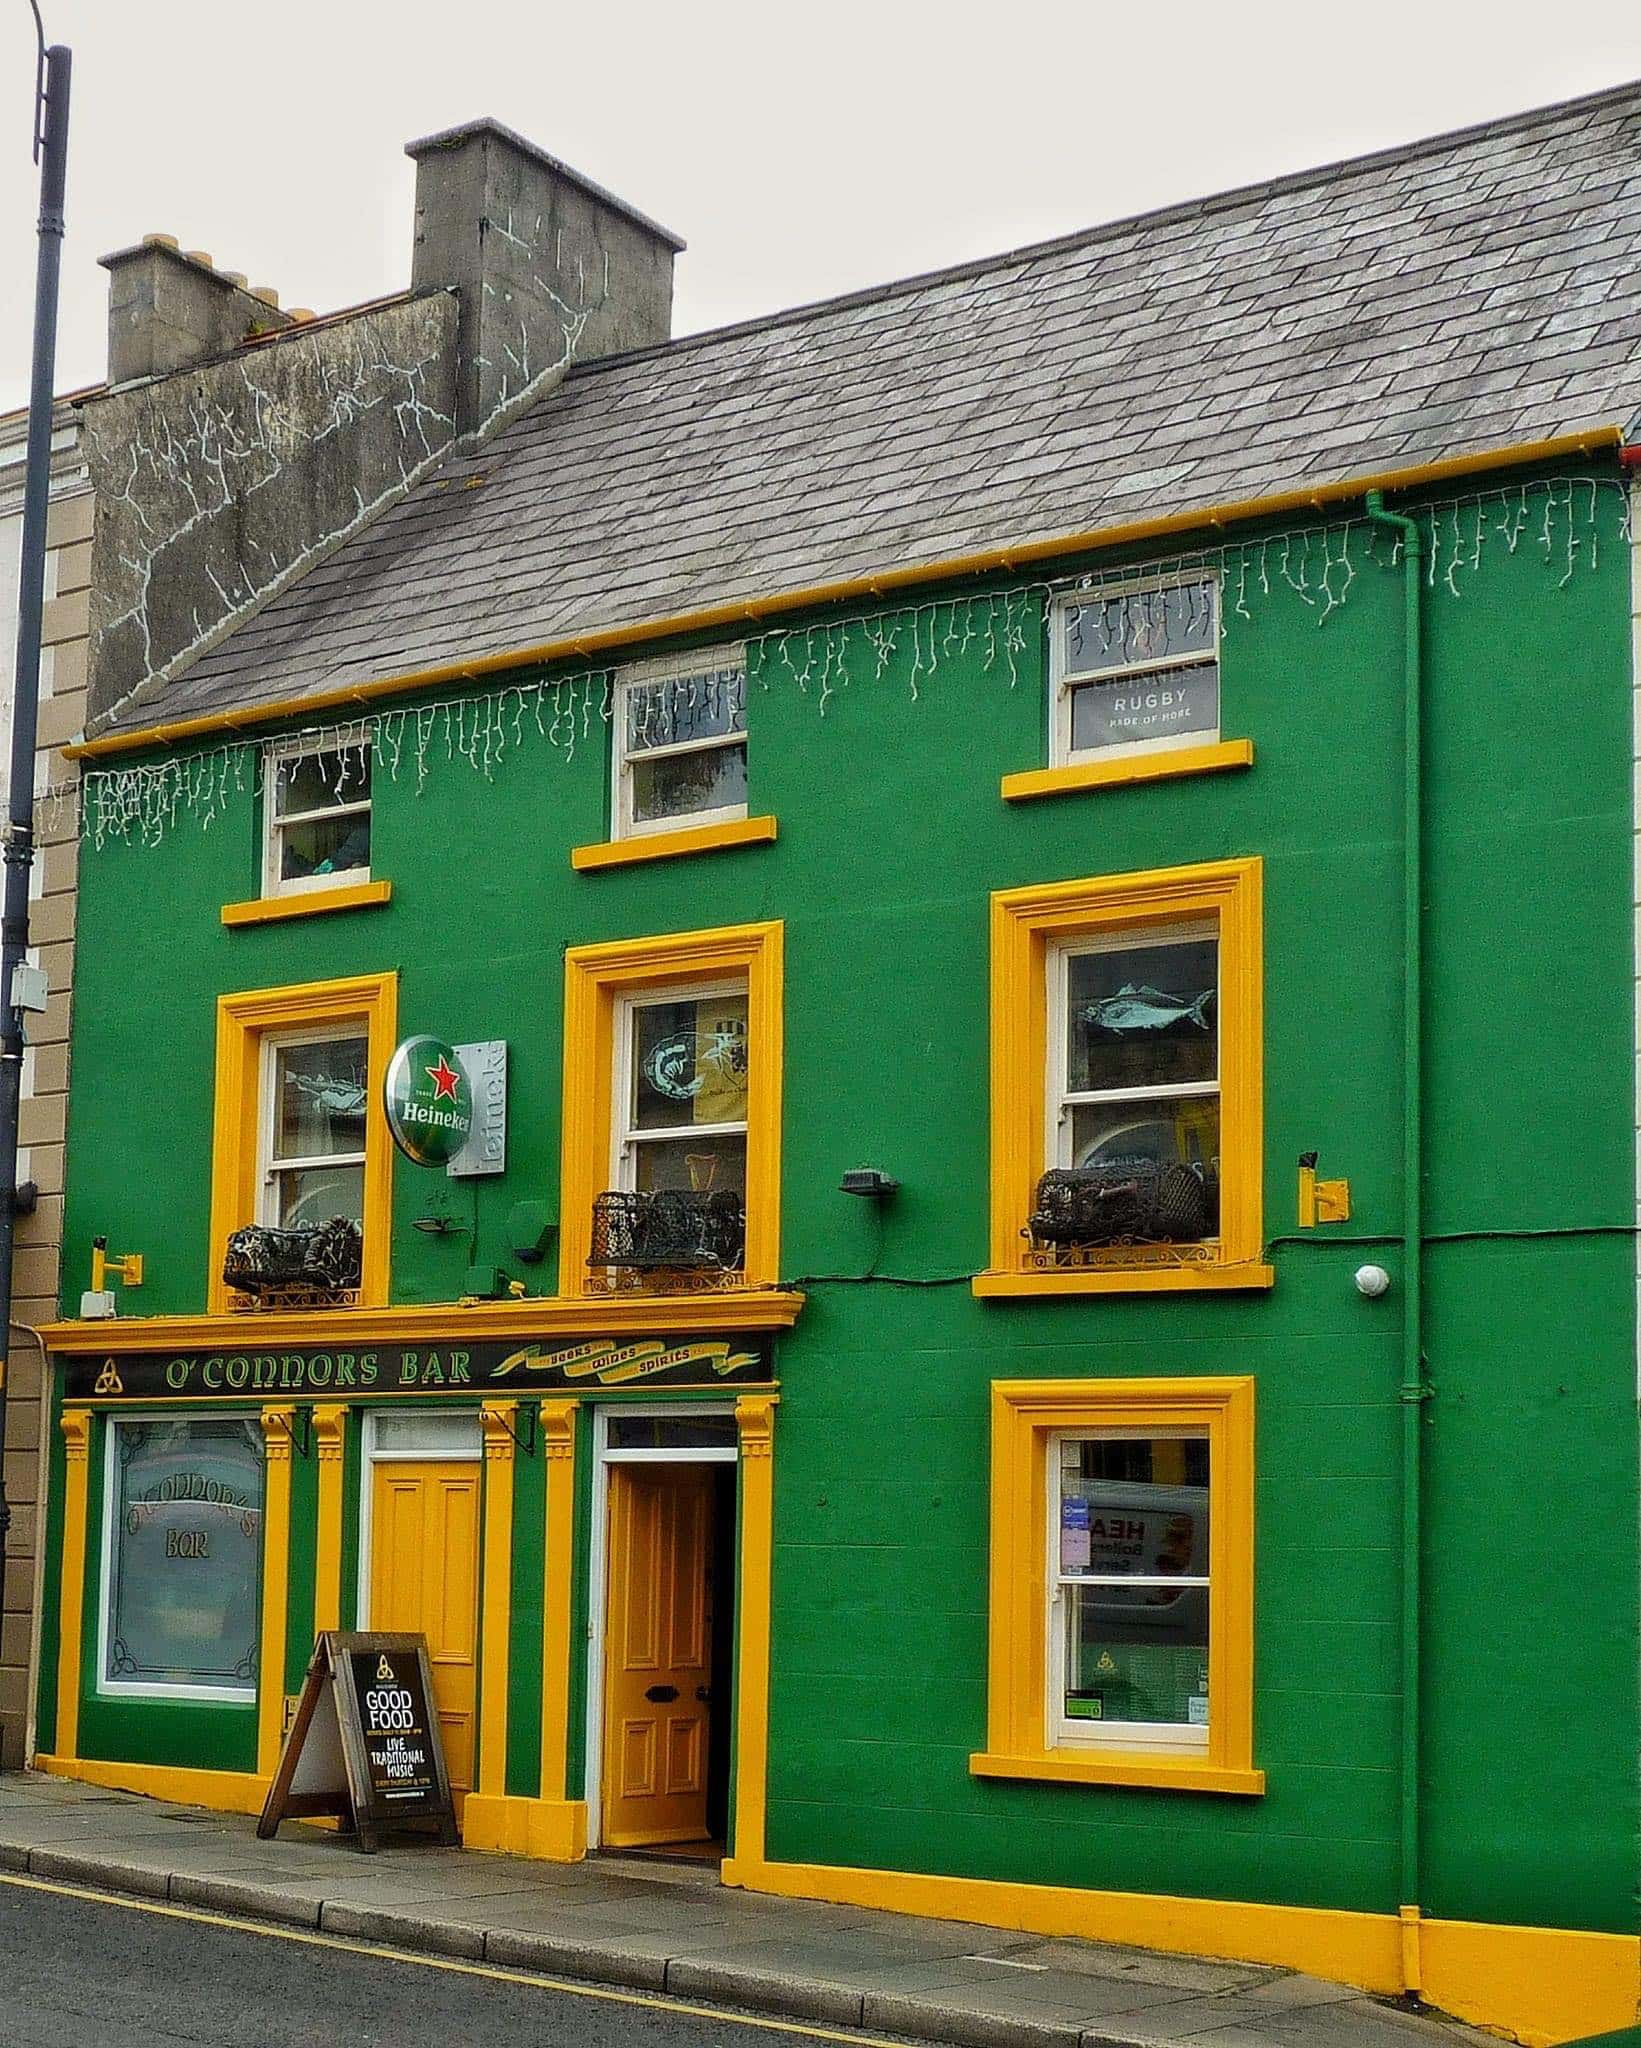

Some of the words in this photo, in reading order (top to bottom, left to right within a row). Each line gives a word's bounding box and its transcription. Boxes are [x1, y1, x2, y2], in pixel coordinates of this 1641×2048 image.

[1114, 688, 1187, 711] RUGBY
[1109, 715, 1138, 728] MADE
[1142, 713, 1158, 724] OF
[1162, 708, 1192, 722] MORE
[399, 1351, 472, 1385] BAR
[366, 1690, 413, 1710] GOOD
[369, 1710, 414, 1729] FOOD
[386, 1737, 405, 1751] LIVE
[371, 1750, 426, 1767] TRADITIONAL
[387, 1764, 415, 1778] MUSIC
